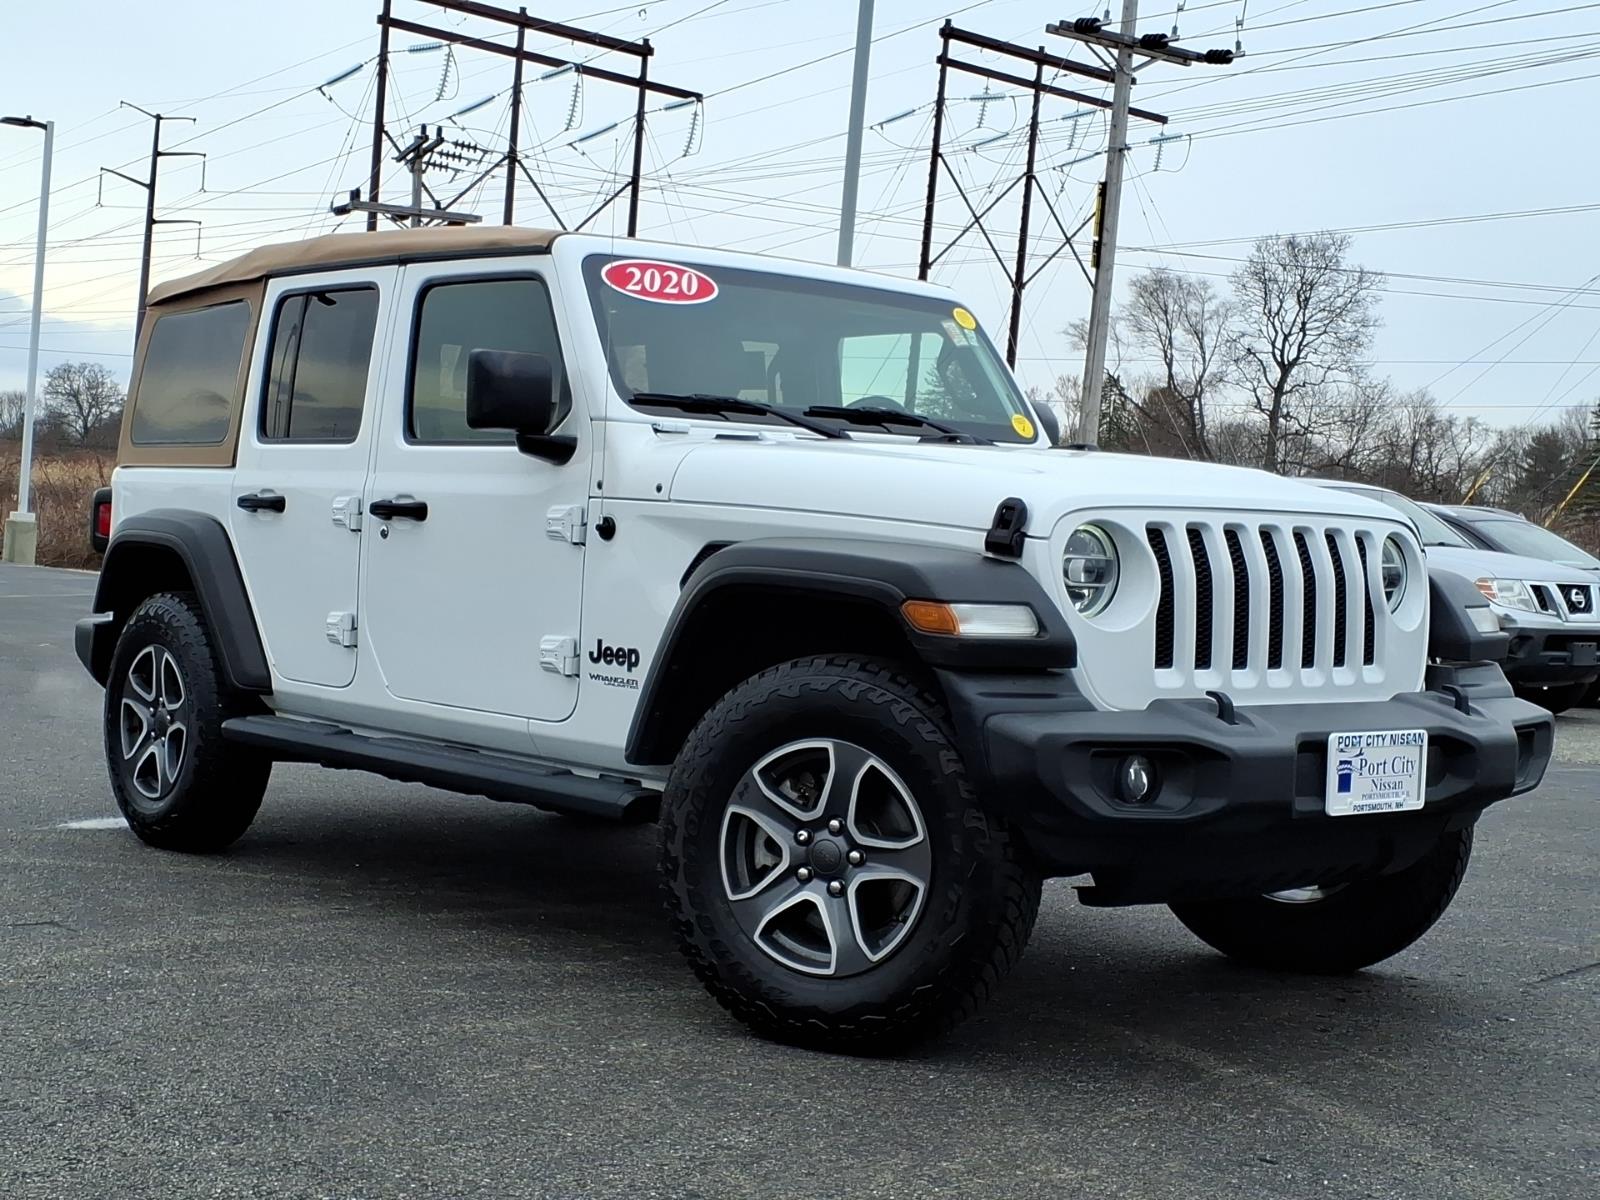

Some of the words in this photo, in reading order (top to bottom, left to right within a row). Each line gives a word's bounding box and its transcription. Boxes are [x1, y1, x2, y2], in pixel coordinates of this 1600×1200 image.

[625, 267, 699, 295] 2020
[588, 638, 641, 673] Jeep
[588, 672, 639, 686] WRANGLER
[1365, 734, 1387, 747] CITY
[1389, 732, 1424, 746] NISSAN
[1358, 757, 1387, 777] Port
[1391, 755, 1416, 778] City
[1371, 778, 1404, 792] Nissan
[1394, 801, 1404, 810] NH
